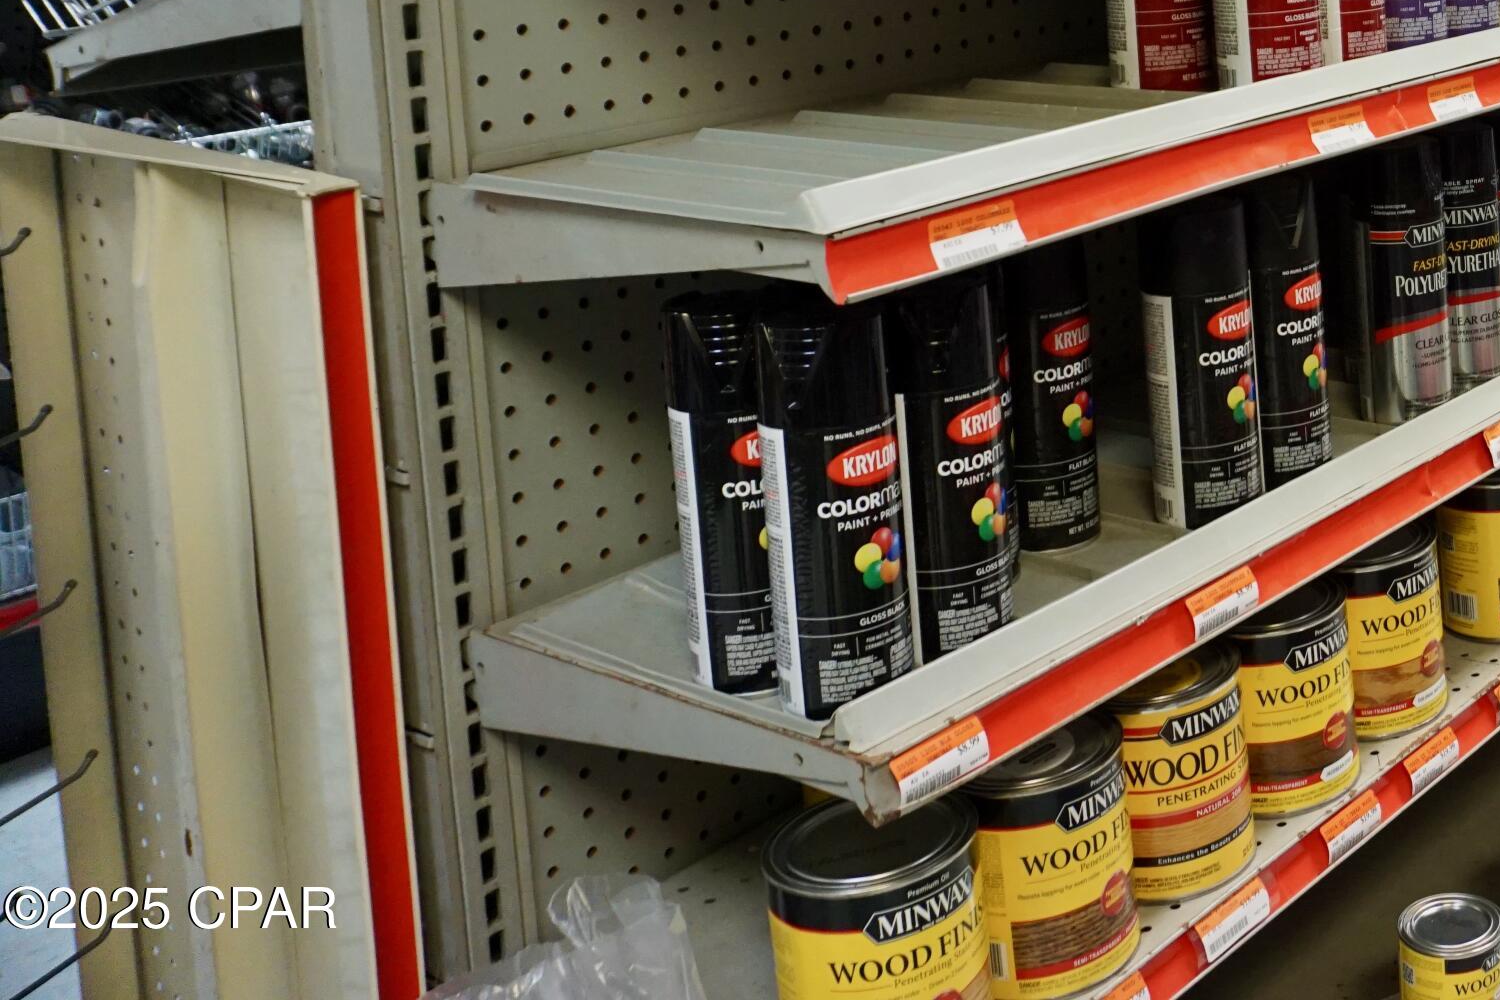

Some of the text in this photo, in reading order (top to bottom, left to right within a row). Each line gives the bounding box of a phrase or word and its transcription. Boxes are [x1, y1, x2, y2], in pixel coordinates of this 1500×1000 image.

[1446, 233, 1500, 252] AST-DRYING
[1291, 335, 1313, 346] PAINT
[1415, 335, 1444, 350] CLEAR
[1050, 381, 1074, 394] PAINT
[1214, 366, 1238, 377] PAINT
[842, 439, 896, 480] KRYLON
[1068, 461, 1083, 472] FLAT
[956, 472, 983, 489] PAINT
[817, 481, 901, 521] COLORma
[837, 516, 870, 532] PAINT
[976, 559, 999, 577] GLOSS
[860, 601, 906, 628] GLOSS BLACK
[1360, 603, 1427, 637] WOOD
[1256, 673, 1330, 709] WOOD
[1172, 687, 1240, 743] MINWAX
[1124, 744, 1219, 789] WOOD
[1066, 767, 1125, 828] MINWA
[1157, 769, 1237, 808] PENETRATING
[1195, 794, 1230, 819] NATURAL
[1020, 830, 1107, 877] WOOD
[1157, 829, 1239, 866] Enhances the Beauty of
[907, 871, 950, 899] Premium Oil
[877, 872, 973, 940] MINWAX
[828, 902, 983, 985] WOOD FINIS
[894, 957, 952, 989] Penetrating
